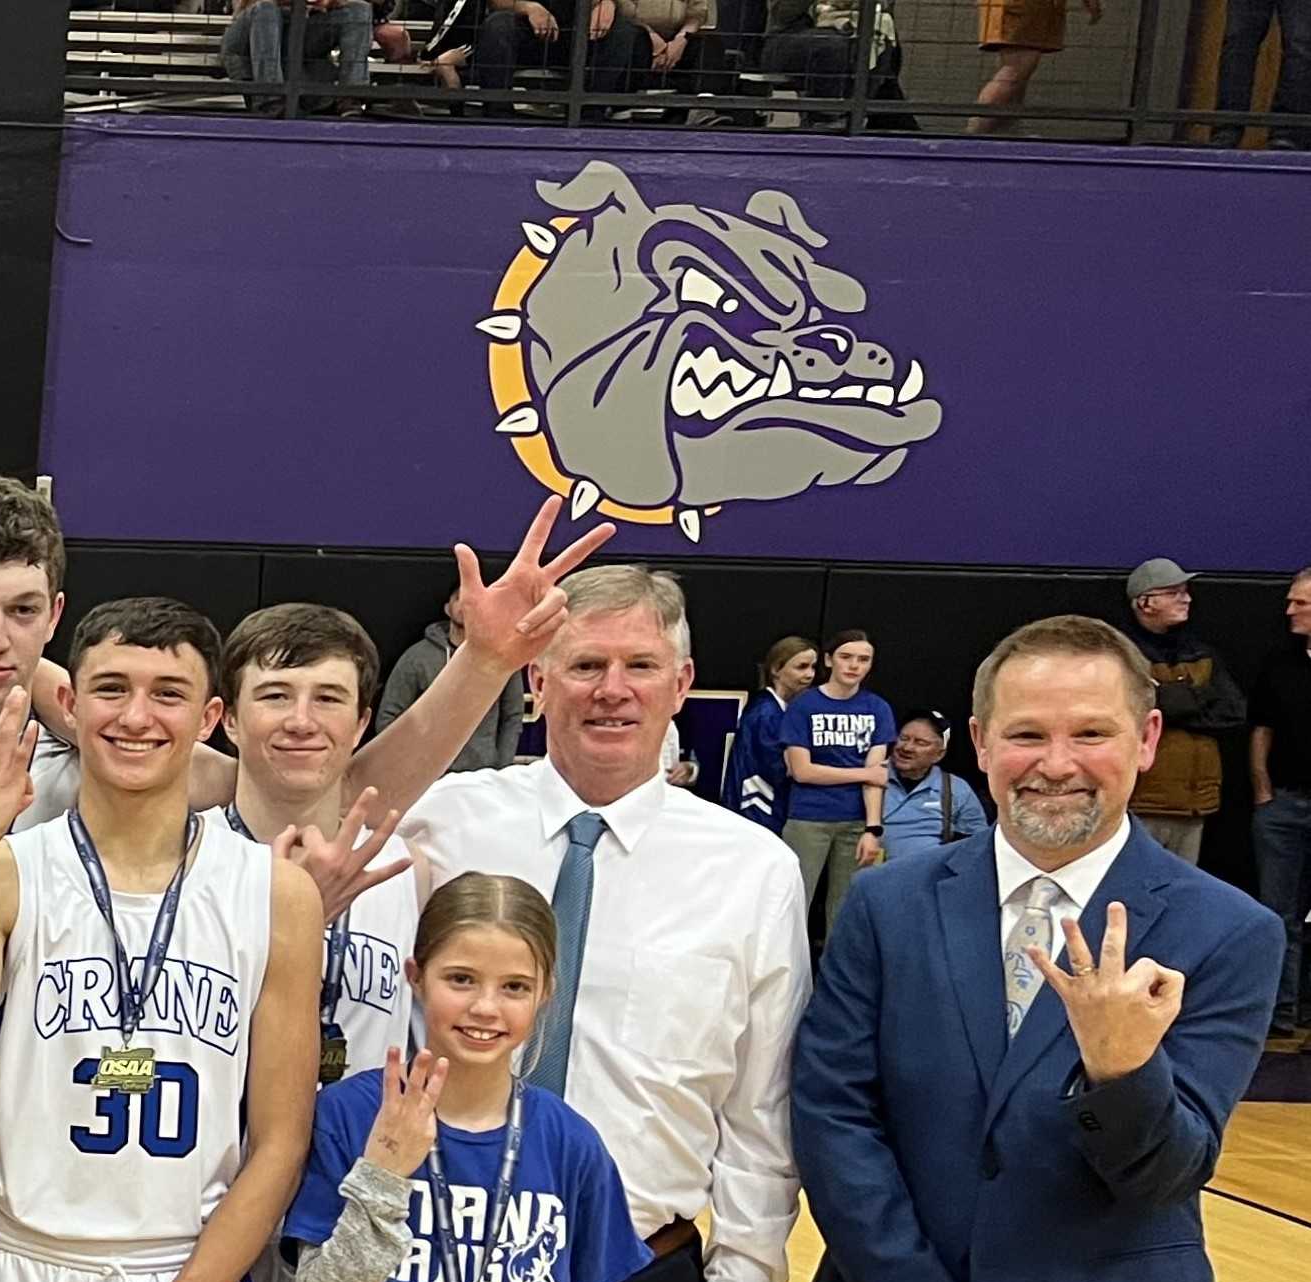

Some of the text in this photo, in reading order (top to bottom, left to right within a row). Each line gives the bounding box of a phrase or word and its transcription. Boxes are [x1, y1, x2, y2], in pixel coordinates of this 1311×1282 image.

[811, 713, 875, 732] STANG
[813, 731, 856, 747] GANG
[100, 1059, 153, 1076] OSAA
[69, 1057, 199, 1159] 30
[409, 1179, 567, 1251] TANG
